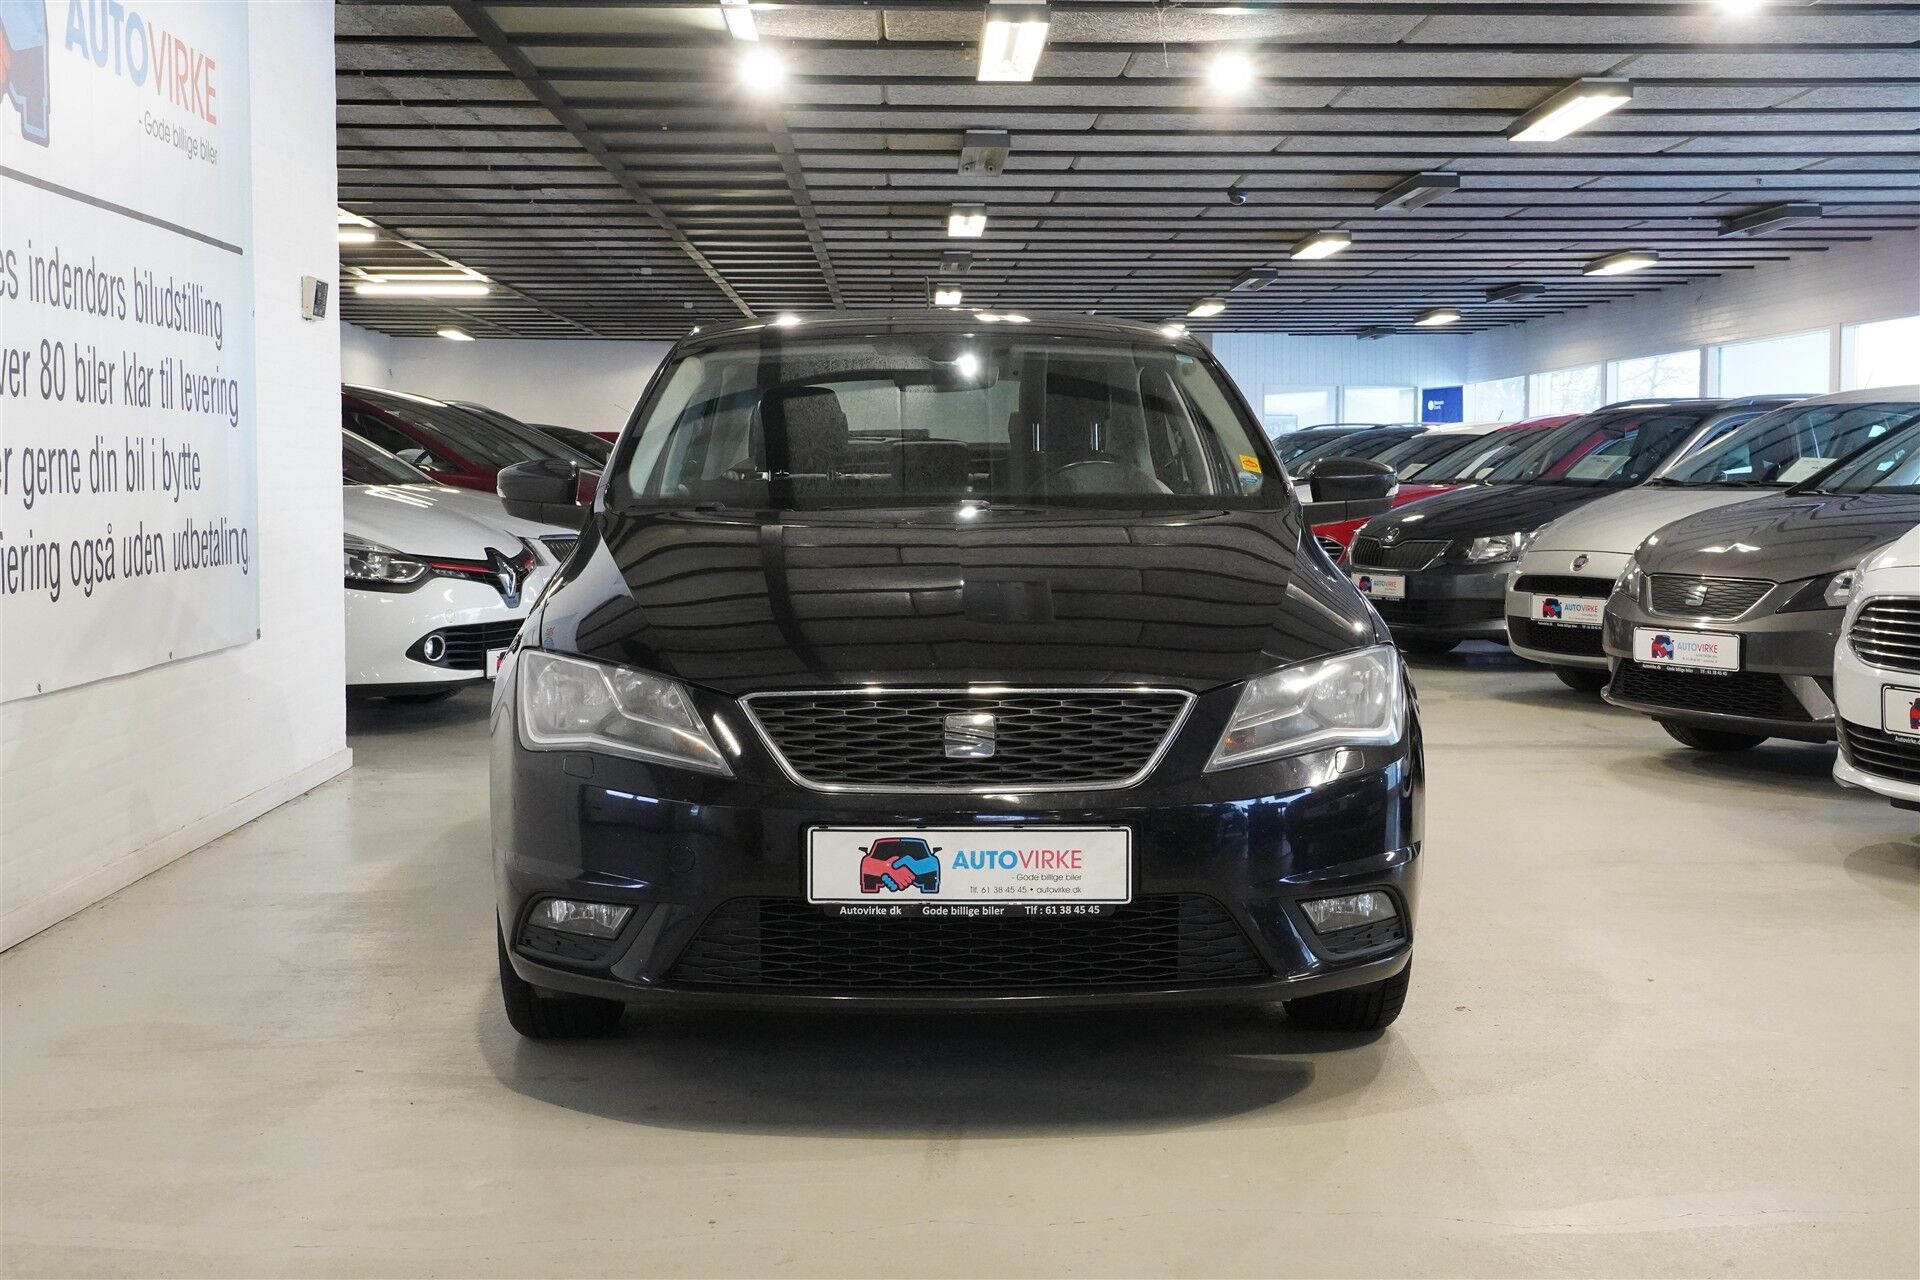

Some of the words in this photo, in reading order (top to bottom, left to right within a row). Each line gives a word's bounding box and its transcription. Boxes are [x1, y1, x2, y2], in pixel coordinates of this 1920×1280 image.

[65, 0, 217, 126] AUTOVIRKE
[144, 109, 171, 144] Gode
[172, 122, 199, 160] billige
[200, 136, 218, 165] biler
[28, 239, 126, 321] indendørs
[133, 266, 223, 351] biludstilling
[40, 338, 66, 402] 80
[74, 343, 116, 405] biler
[122, 350, 154, 408] klar
[159, 357, 174, 410] til
[179, 359, 239, 428] levering
[22, 447, 81, 510] gerne
[89, 435, 118, 494] din
[125, 436, 145, 493] bil
[151, 437, 156, 491] i
[162, 437, 201, 503] bytte
[70, 522, 116, 598] også
[123, 521, 166, 579] uden
[173, 517, 249, 575] udbetaling
[1564, 603, 1599, 613] AUTOVIRKE
[1677, 642, 1719, 654] AUTOVIRKE
[952, 850, 1082, 870] AUTOVIRKE
[1016, 874, 1039, 882] Gode
[1041, 873, 1064, 883] billige
[1065, 873, 1082, 881] biler
[981, 886, 990, 894] 61
[993, 886, 1003, 894] 38
[1005, 886, 1015, 894] 45
[1017, 886, 1028, 894] 45
[922, 906, 949, 916] Gode
[951, 906, 980, 918] billige
[982, 906, 1005, 916] biler
[1024, 905, 1038, 915] Tlf
[1045, 905, 1058, 915] 61
[1060, 905, 1072, 915] 38
[1074, 905, 1086, 914] 45
[1088, 905, 1101, 914] 45
